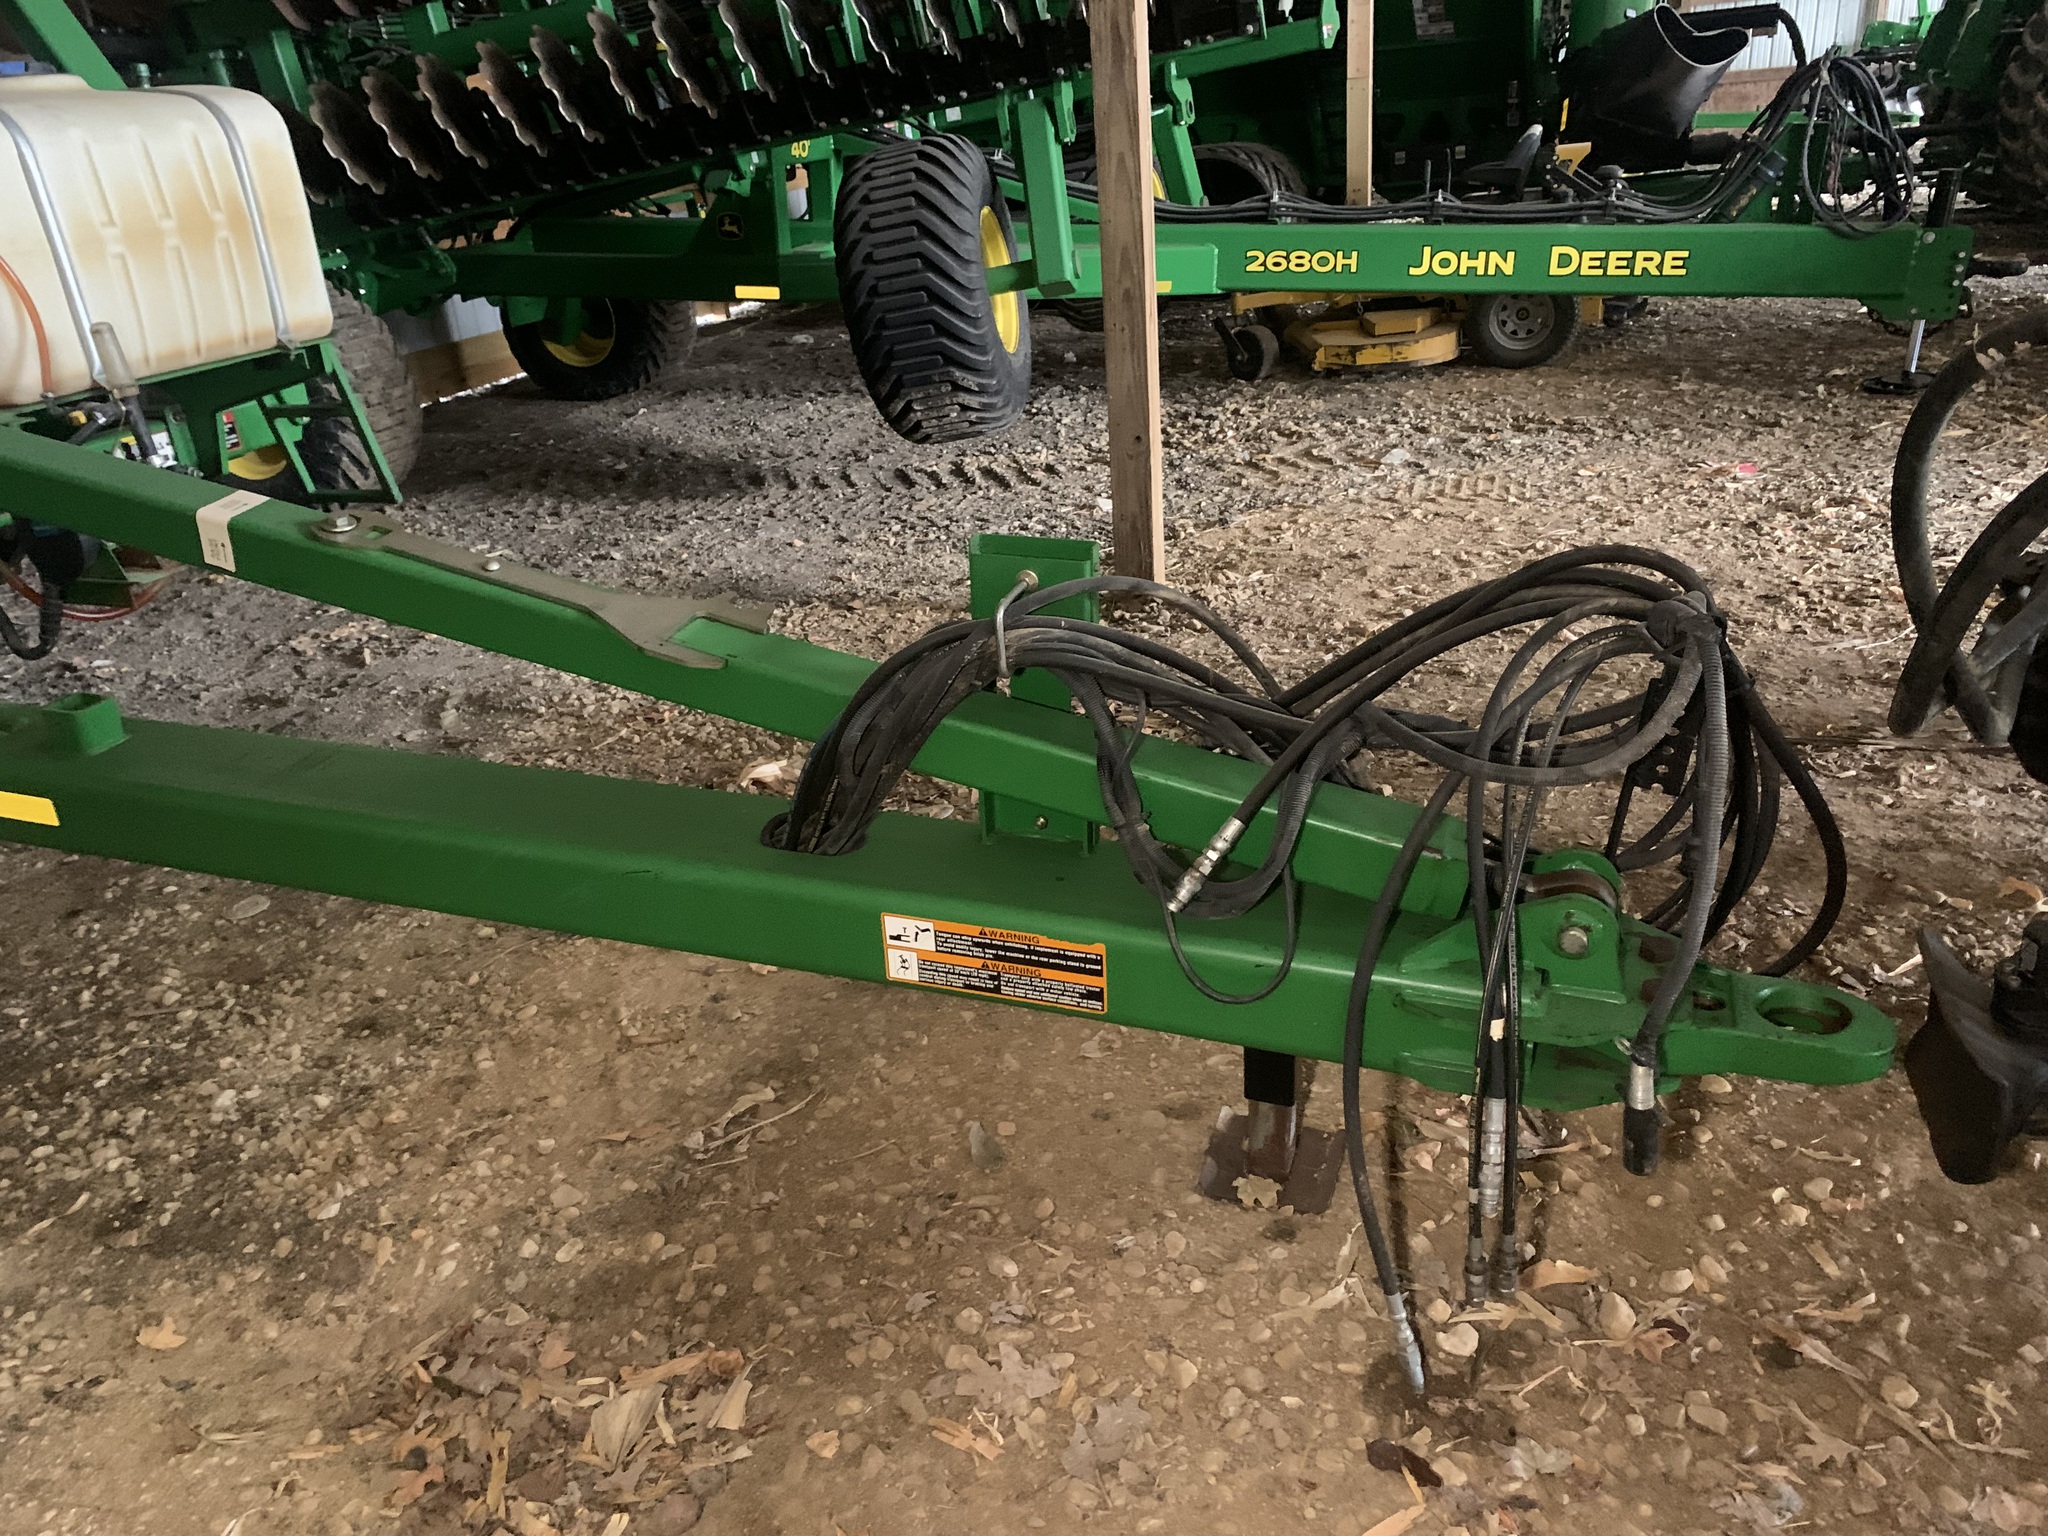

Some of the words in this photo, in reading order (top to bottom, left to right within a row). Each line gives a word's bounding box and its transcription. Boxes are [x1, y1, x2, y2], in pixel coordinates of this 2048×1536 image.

[1244, 250, 1358, 273] 2680H
[1408, 246, 1515, 276] JOHN
[1549, 246, 1689, 276] DEERE
[988, 931, 1040, 944] WARNING
[990, 963, 1042, 977] WARNING
